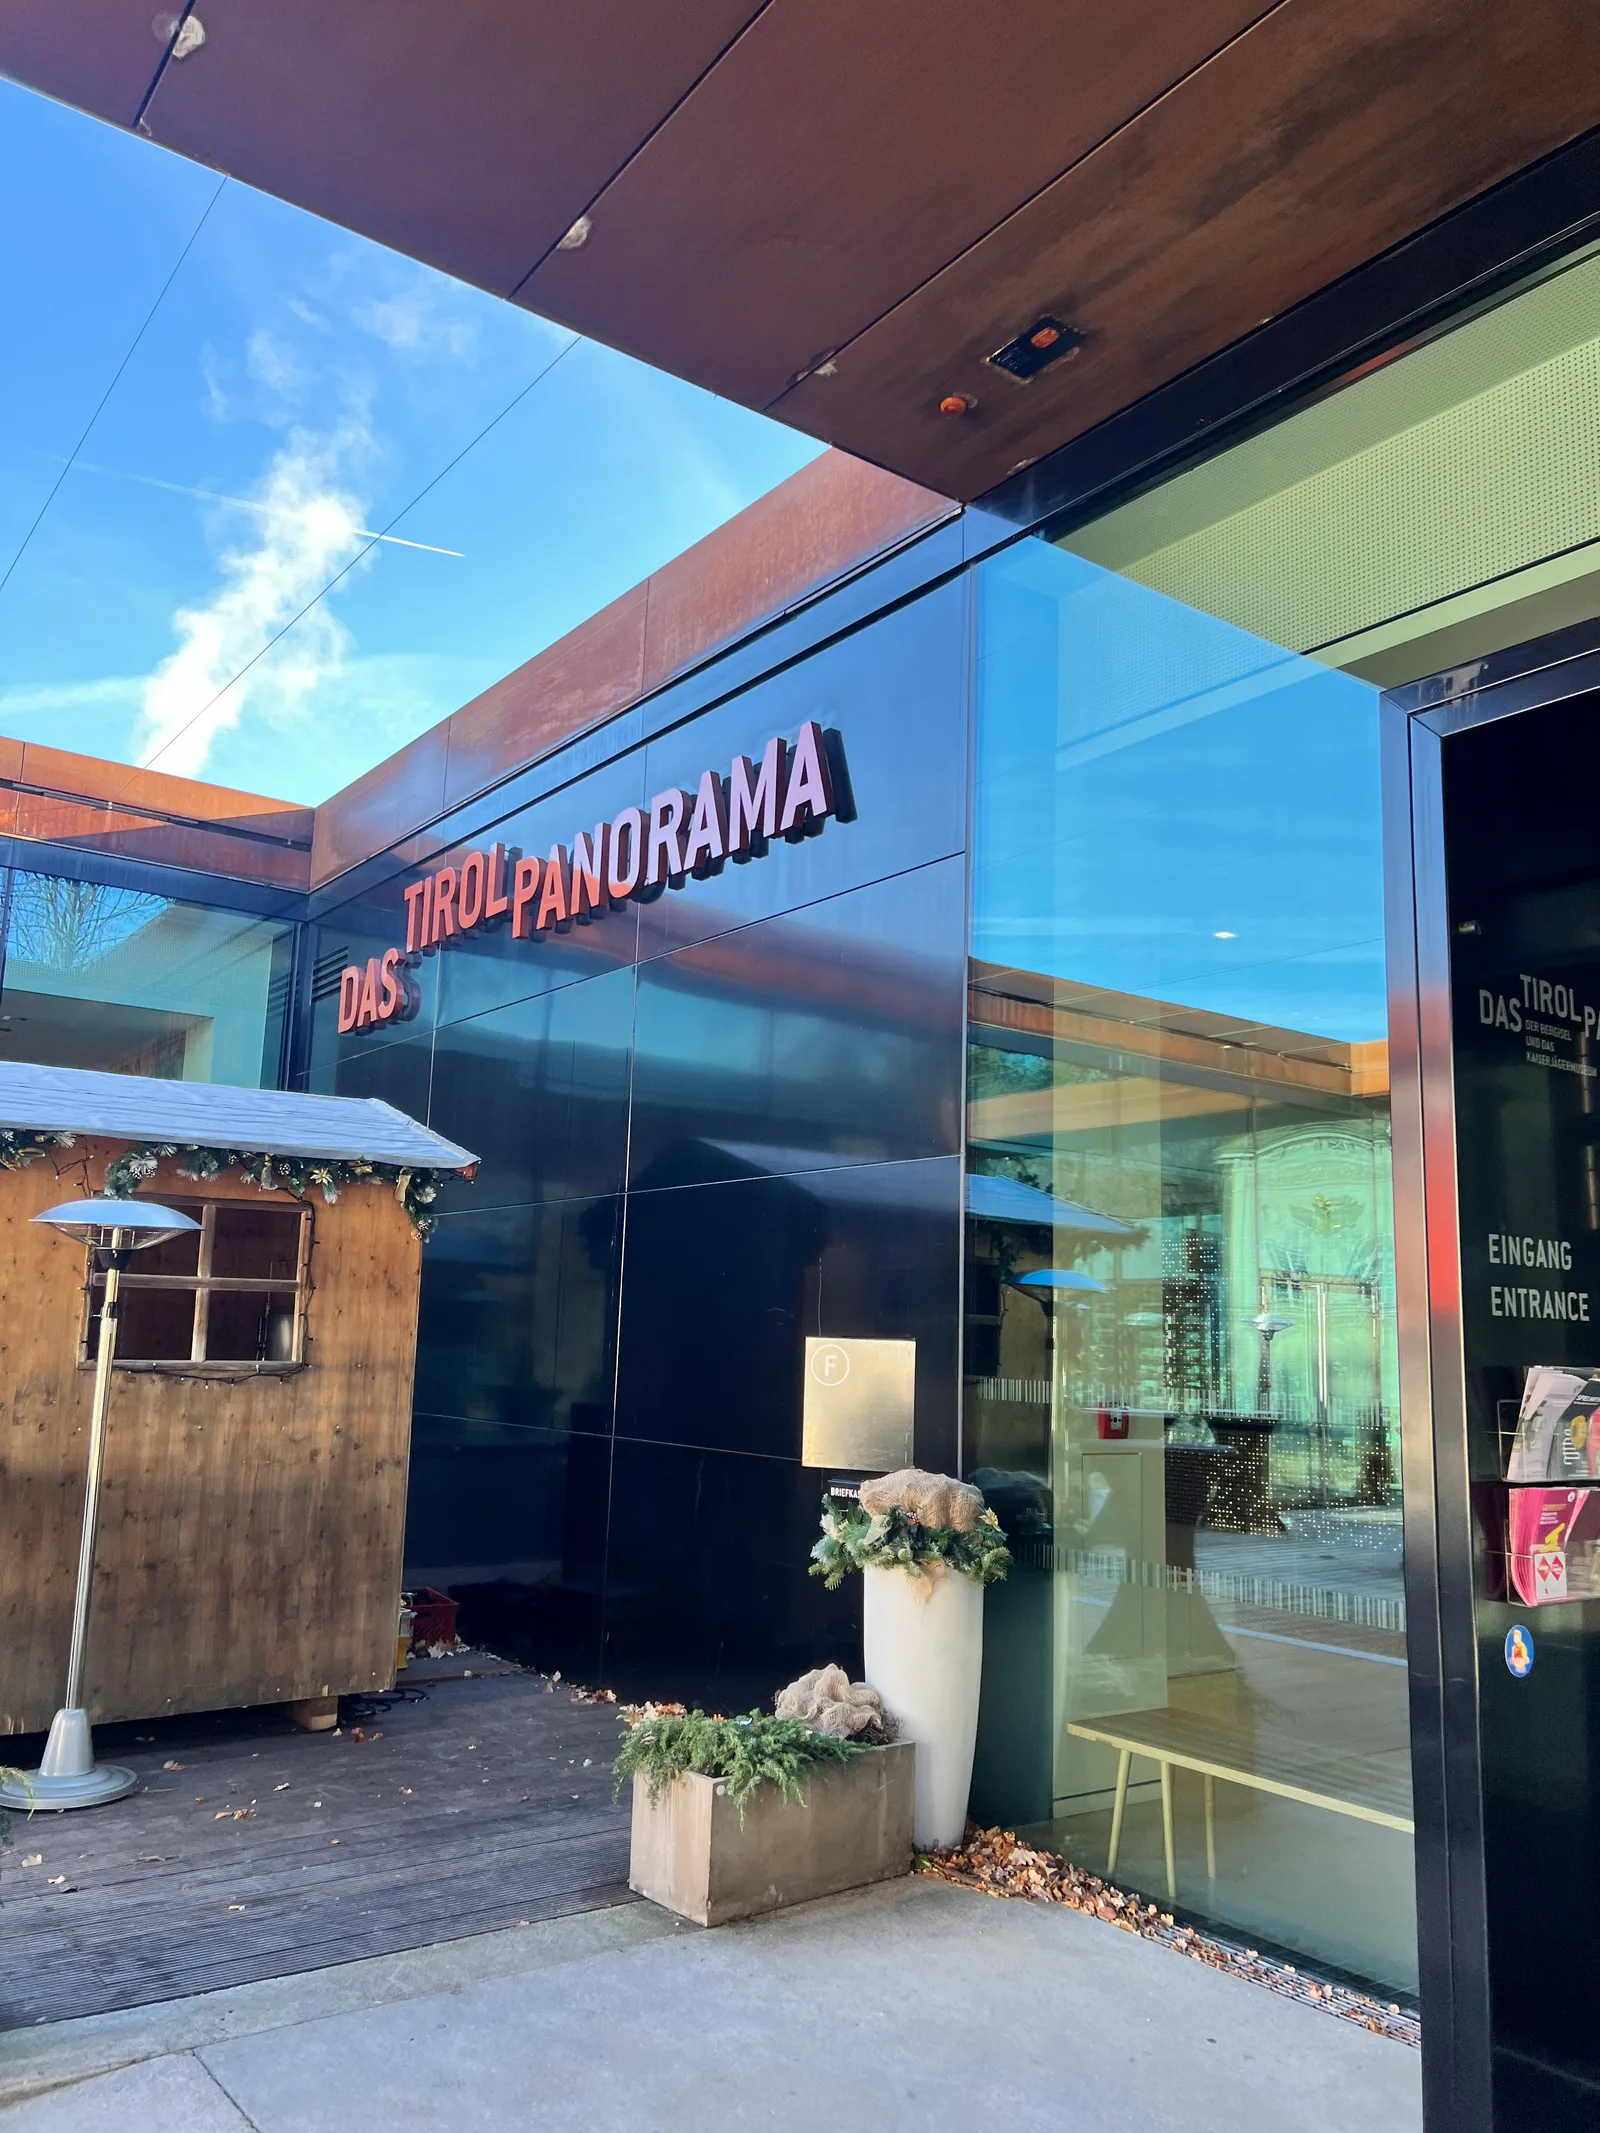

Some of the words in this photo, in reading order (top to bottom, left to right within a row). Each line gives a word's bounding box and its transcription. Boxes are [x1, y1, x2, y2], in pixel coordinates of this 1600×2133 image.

[338, 948, 403, 1034] DAS
[1479, 989, 1523, 1033] DAS
[1488, 1233, 1572, 1271] EINGANG
[1490, 1286, 1590, 1322] ENTRANCE
[824, 1355, 838, 1376] F
